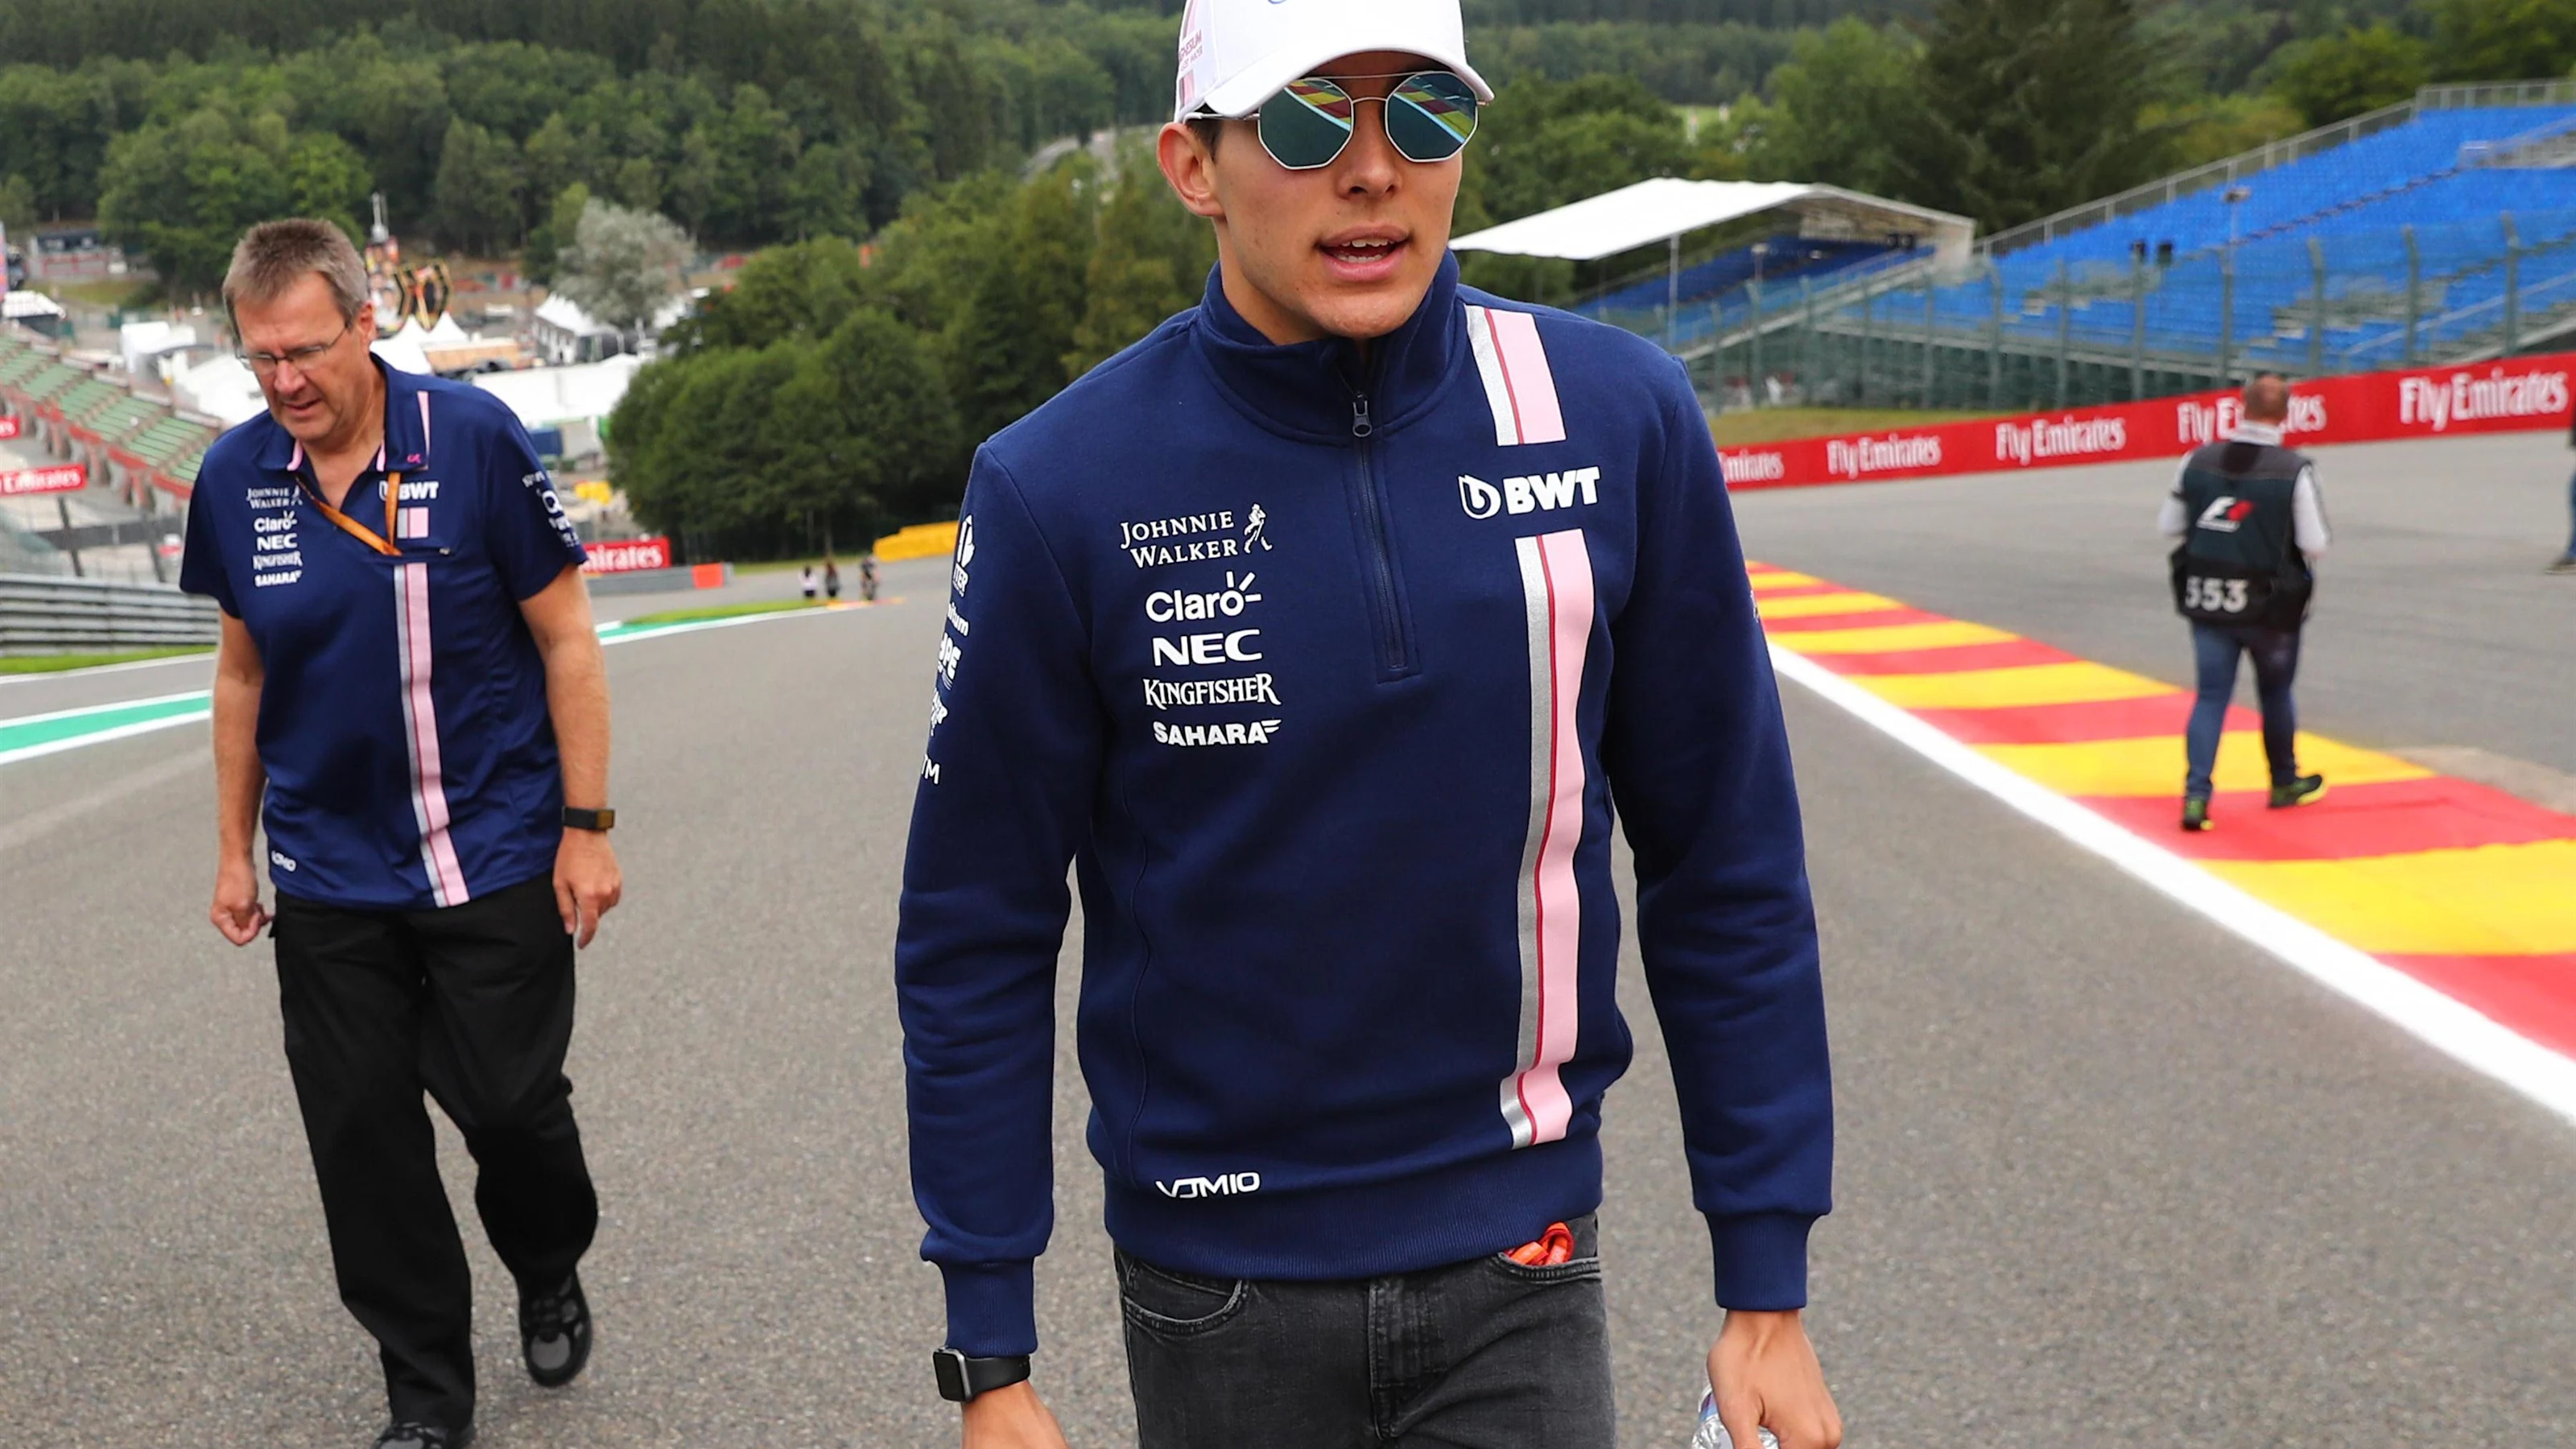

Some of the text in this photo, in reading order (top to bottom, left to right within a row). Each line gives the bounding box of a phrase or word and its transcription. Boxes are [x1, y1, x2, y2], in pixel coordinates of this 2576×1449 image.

[2399, 366, 2569, 432] Fly Emirates
[1995, 414, 2126, 467] Fly Emirates
[2178, 401, 2215, 444] Fly
[1827, 432, 1942, 480] Fly Emirates
[249, 497, 291, 510] WALKER
[398, 481, 440, 501] BWT
[1503, 466, 1600, 515] BWT
[254, 514, 295, 532] Claro
[256, 532, 298, 551] NEC
[1120, 511, 1235, 549] JOHNNIE
[1129, 539, 1239, 568] WALKER
[254, 571, 298, 588] SAHARA
[1146, 581, 1253, 622] Claro
[1152, 629, 1263, 667] NEC
[1142, 673, 1282, 711] KINGFISHER
[1153, 720, 1270, 747] SAHARA
